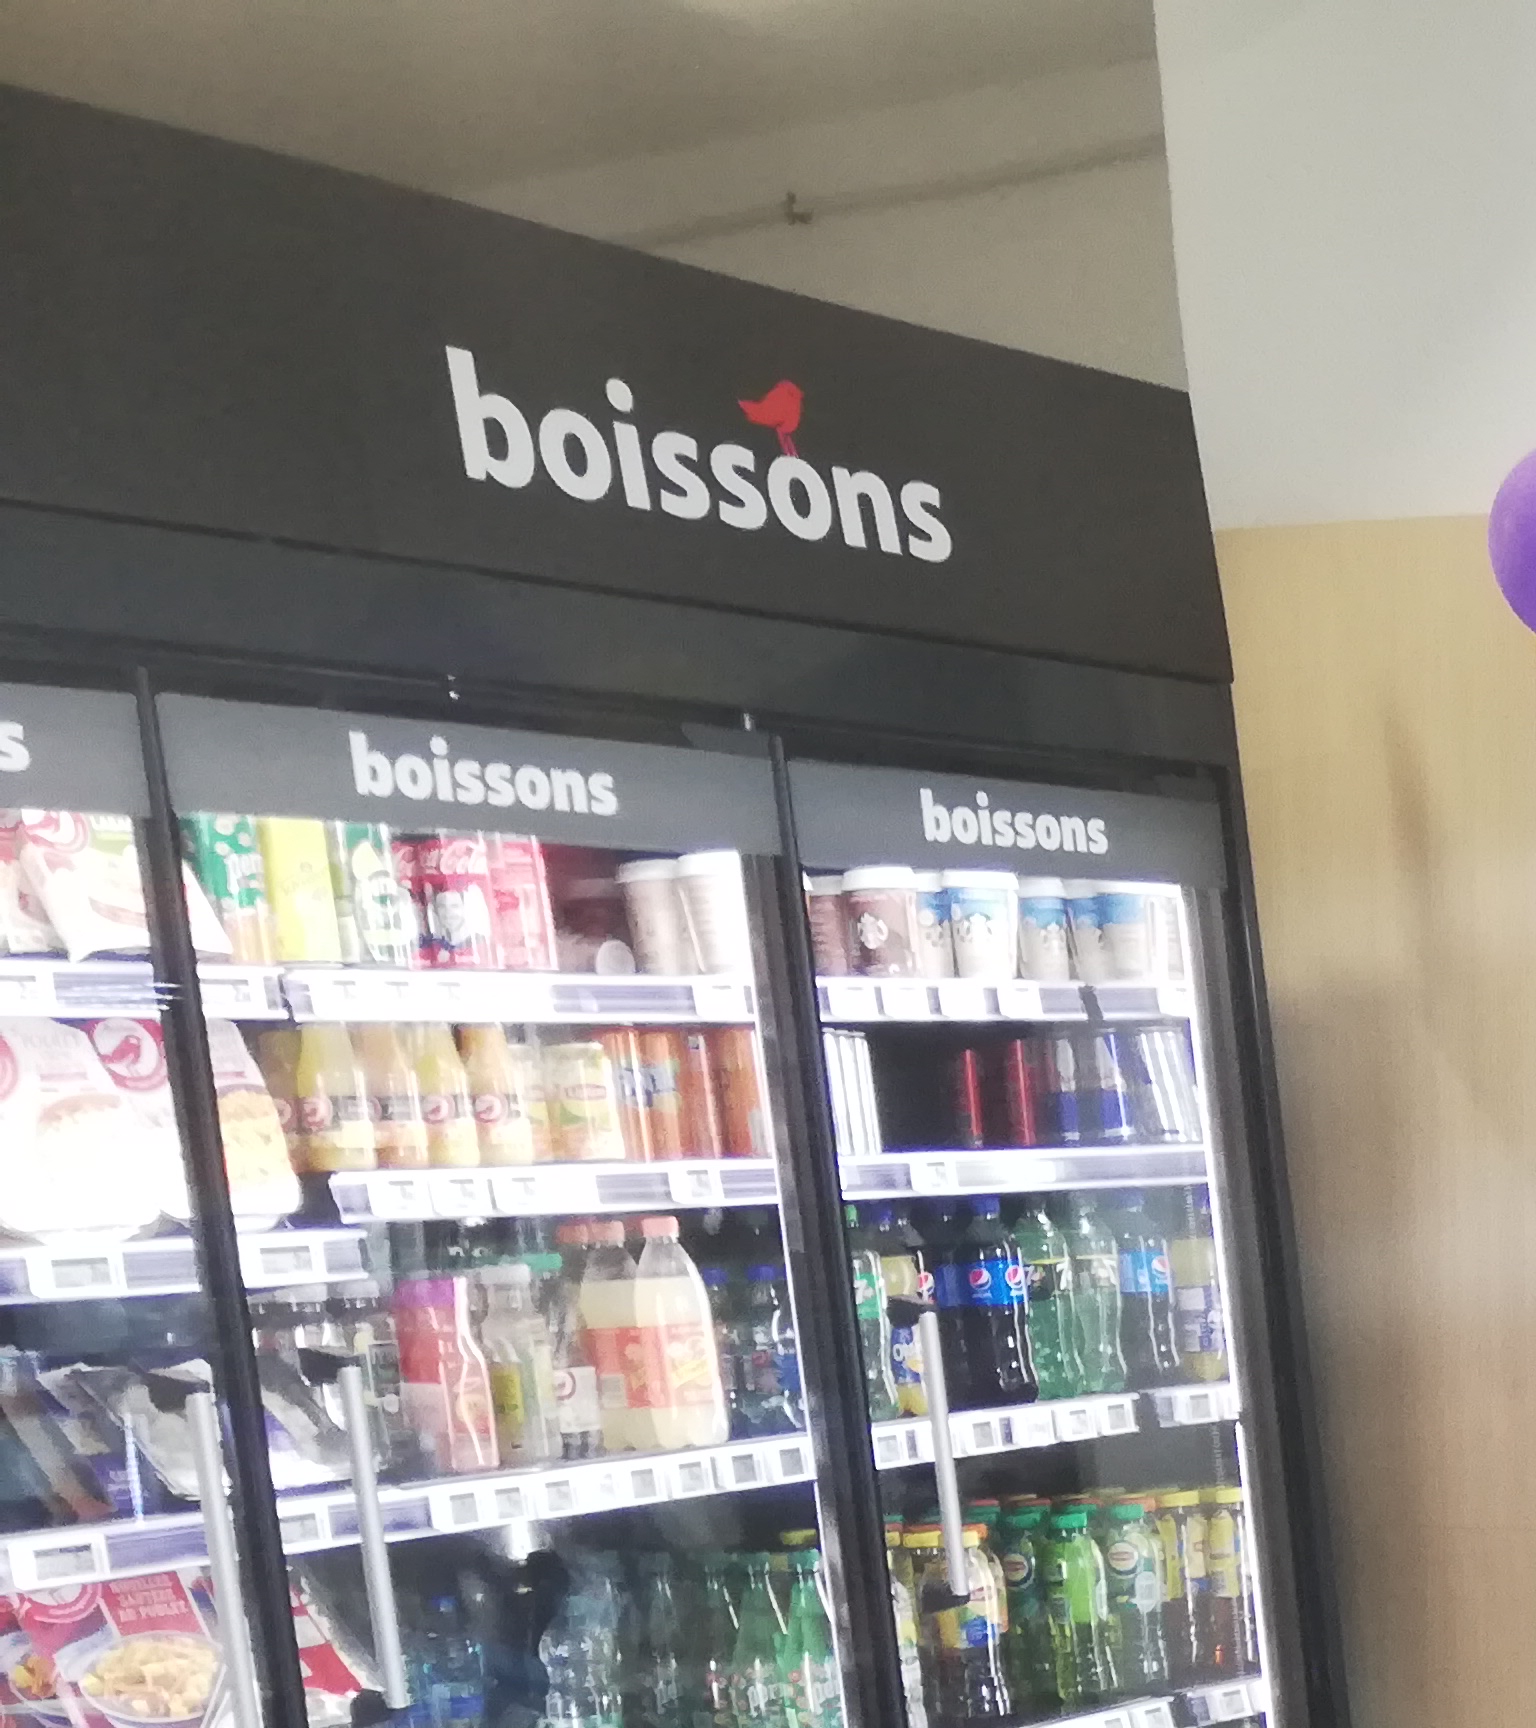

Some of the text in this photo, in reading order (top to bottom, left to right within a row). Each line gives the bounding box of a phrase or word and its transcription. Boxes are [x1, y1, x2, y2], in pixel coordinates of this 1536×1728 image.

[445, 345, 953, 564] boissons
[349, 730, 619, 816] boissons
[920, 788, 1109, 855] boissons
